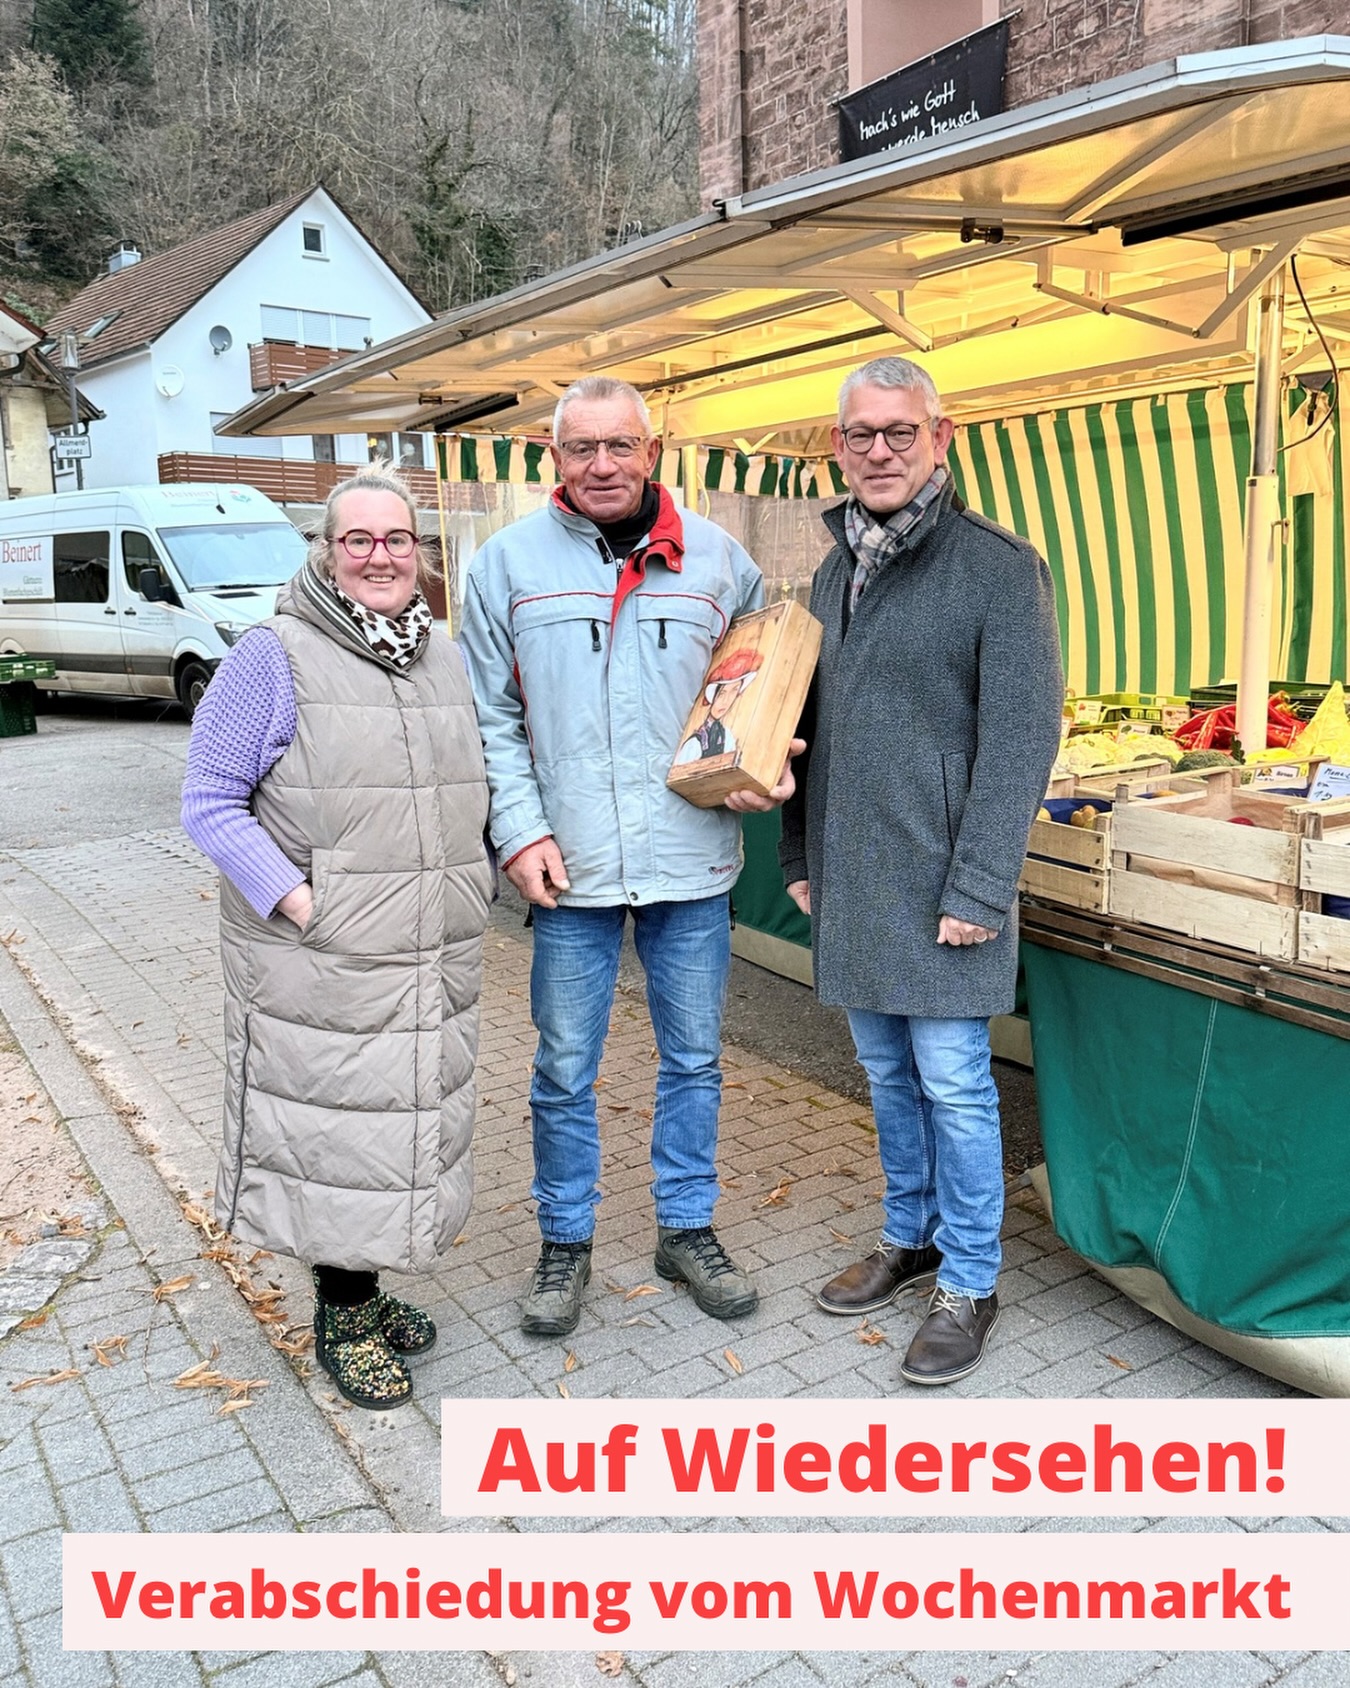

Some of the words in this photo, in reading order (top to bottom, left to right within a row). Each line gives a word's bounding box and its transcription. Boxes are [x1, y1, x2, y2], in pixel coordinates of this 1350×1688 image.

[860, 107, 897, 140] Mach's
[901, 100, 920, 122] wie
[924, 79, 956, 111] Gott
[931, 100, 979, 137] Mensch
[66, 448, 83, 456] platz
[2, 540, 42, 563] Beinert
